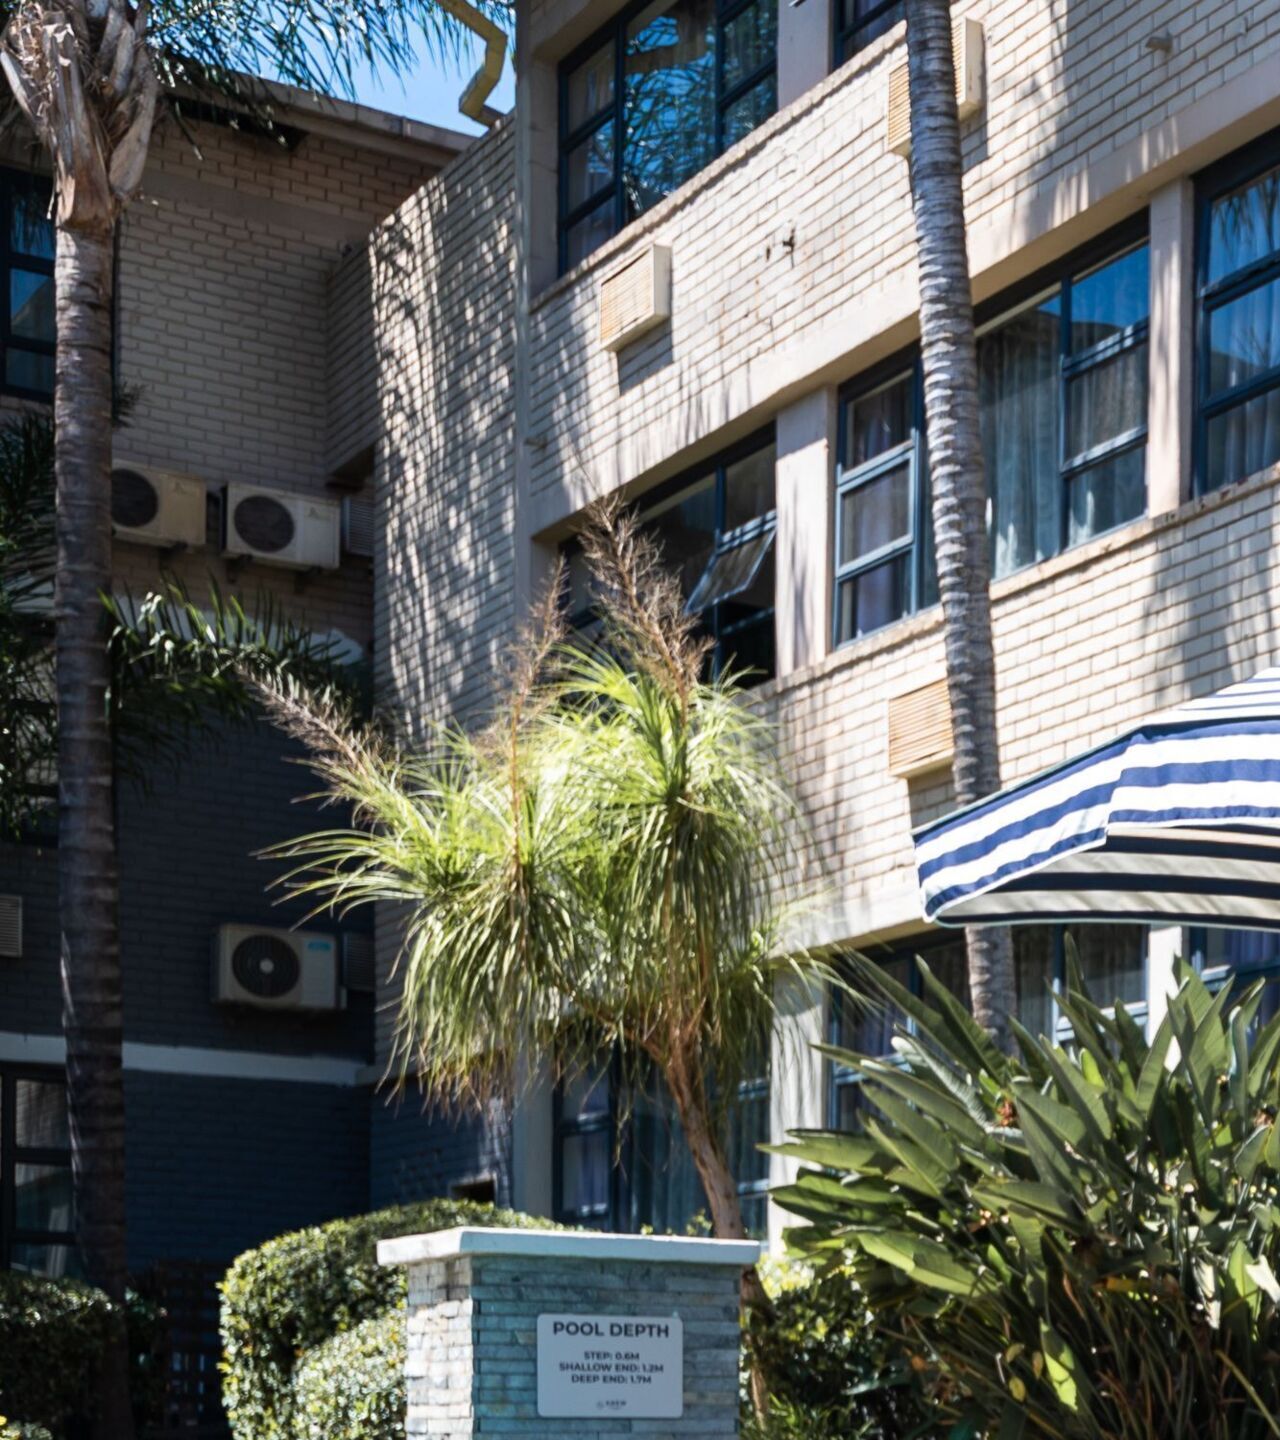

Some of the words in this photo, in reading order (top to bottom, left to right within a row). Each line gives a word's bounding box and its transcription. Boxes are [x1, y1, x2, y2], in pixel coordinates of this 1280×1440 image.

[553, 1321, 605, 1336] POOL
[609, 1322, 669, 1338] DEPTH
[584, 1351, 612, 1360] STEP:
[615, 1352, 639, 1361] 0.6M
[559, 1363, 612, 1372] SHALLOW
[615, 1363, 640, 1372] END:
[642, 1364, 664, 1373] 1.2M
[571, 1374, 600, 1383] DEEP
[603, 1375, 627, 1384] END:
